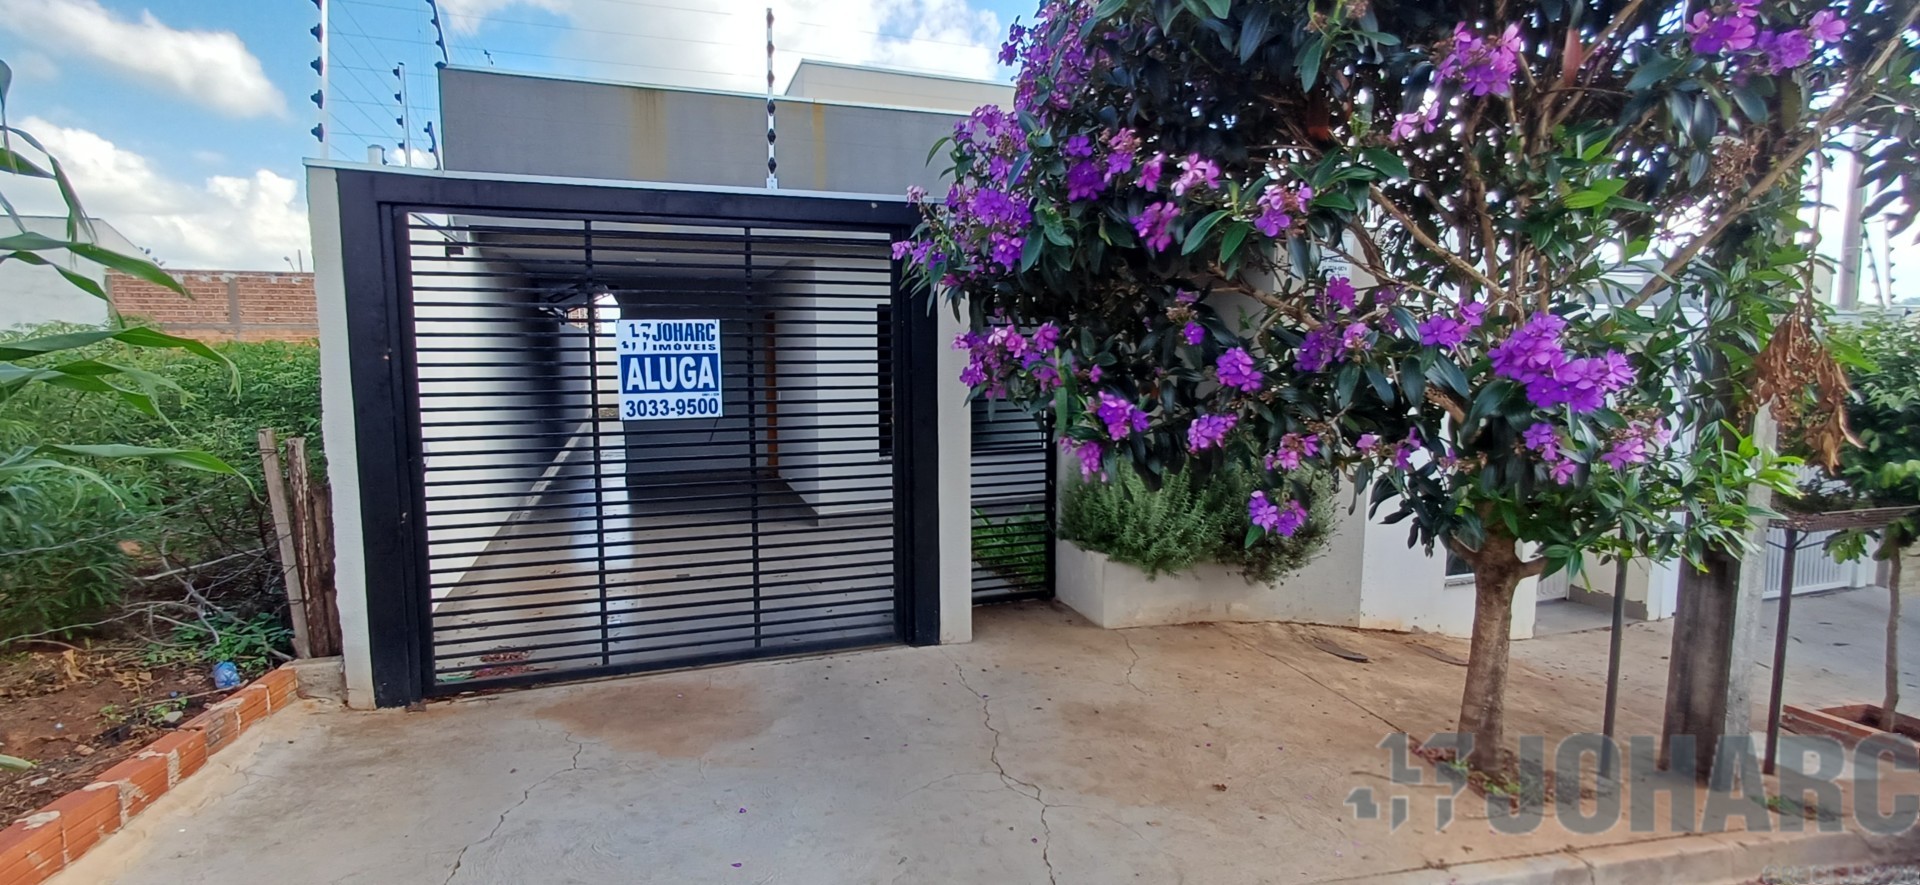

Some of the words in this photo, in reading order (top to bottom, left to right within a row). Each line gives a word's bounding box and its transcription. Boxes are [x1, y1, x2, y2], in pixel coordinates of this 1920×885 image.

[652, 323, 716, 342] JOHARC
[652, 342, 716, 351] IMÓVEIS
[626, 356, 716, 391] ALUGA
[625, 398, 719, 417] 3033-9500
